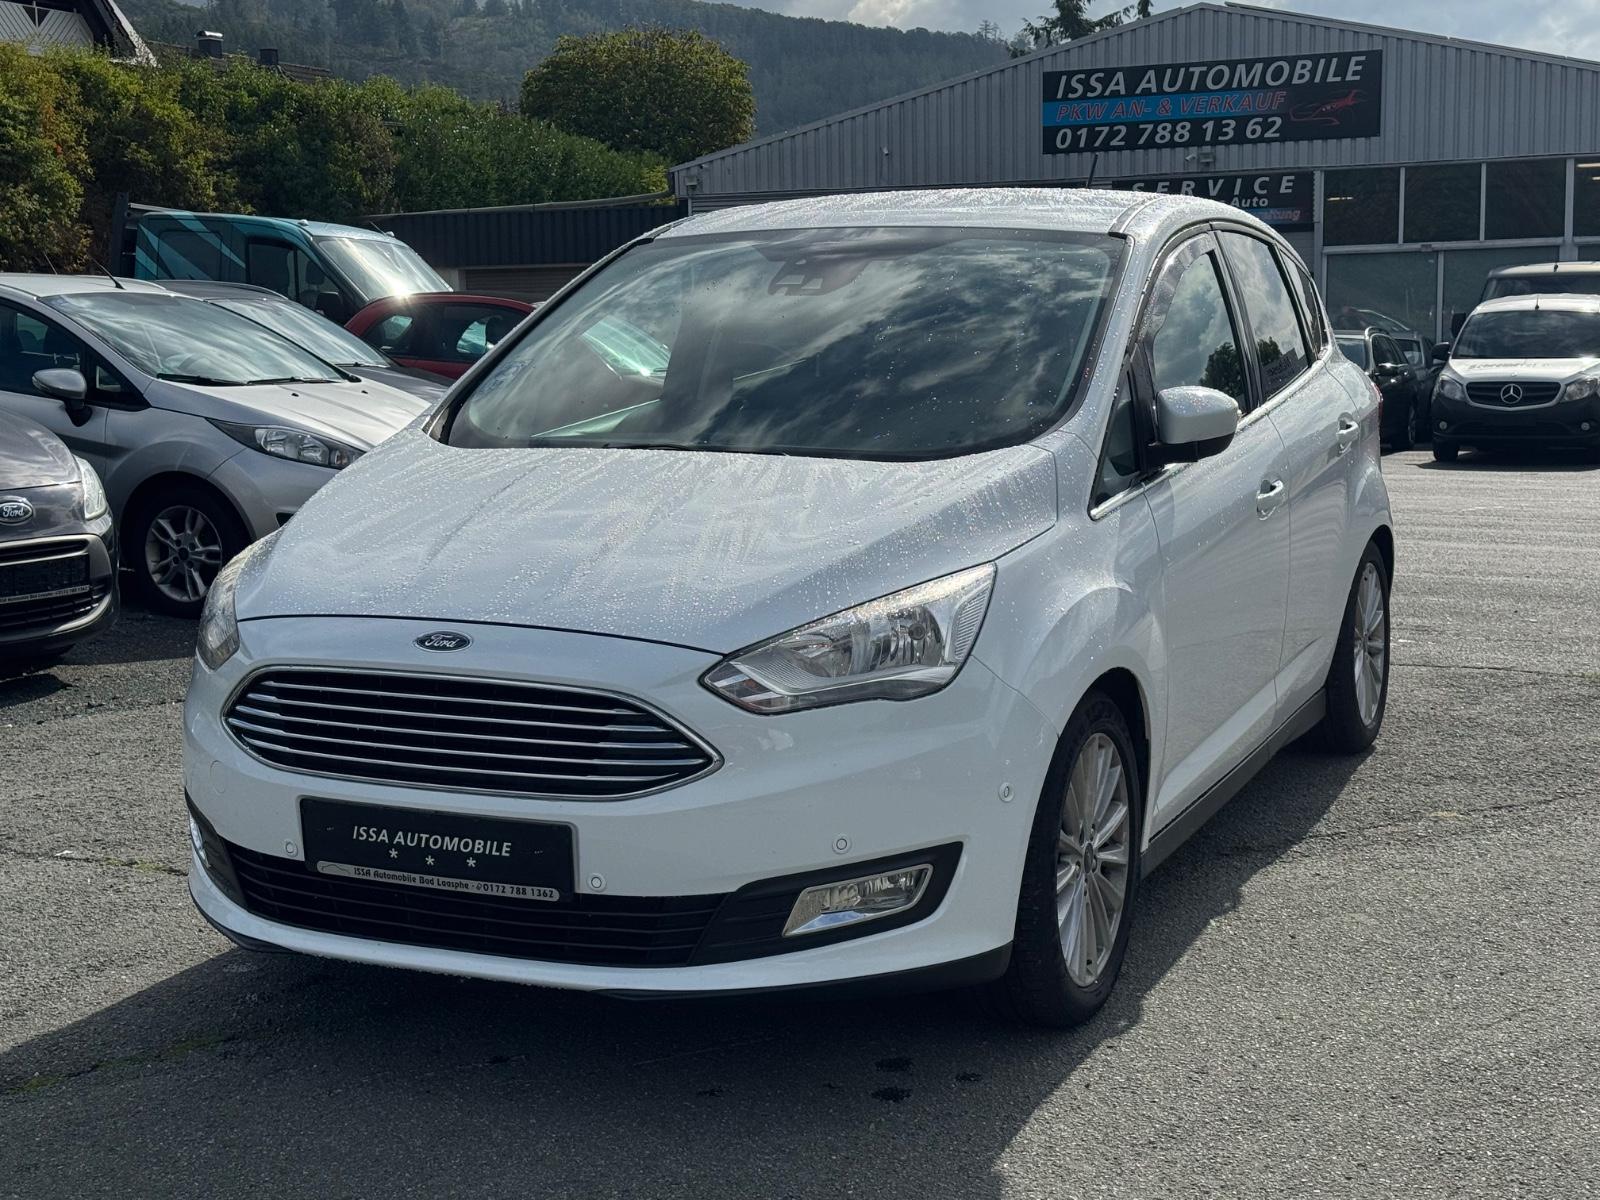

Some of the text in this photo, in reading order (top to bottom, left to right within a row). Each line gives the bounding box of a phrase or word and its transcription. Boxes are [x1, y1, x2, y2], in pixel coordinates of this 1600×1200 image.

[1056, 55, 1366, 99] ISSA AUTOMOBILE
[1056, 103, 1107, 122] PKW
[1157, 98, 1172, 116] &
[1180, 91, 1287, 114] VERKAUF
[1056, 116, 1282, 150] 0172 788 13 62
[1231, 197, 1269, 208] Auto
[2, 505, 24, 518] Ford
[425, 633, 461, 648] Ford
[352, 825, 512, 857] ISSA AUTOMOBILE
[353, 867, 554, 898] ISSA Automobile Bad Laasphe 0172 788 1362
